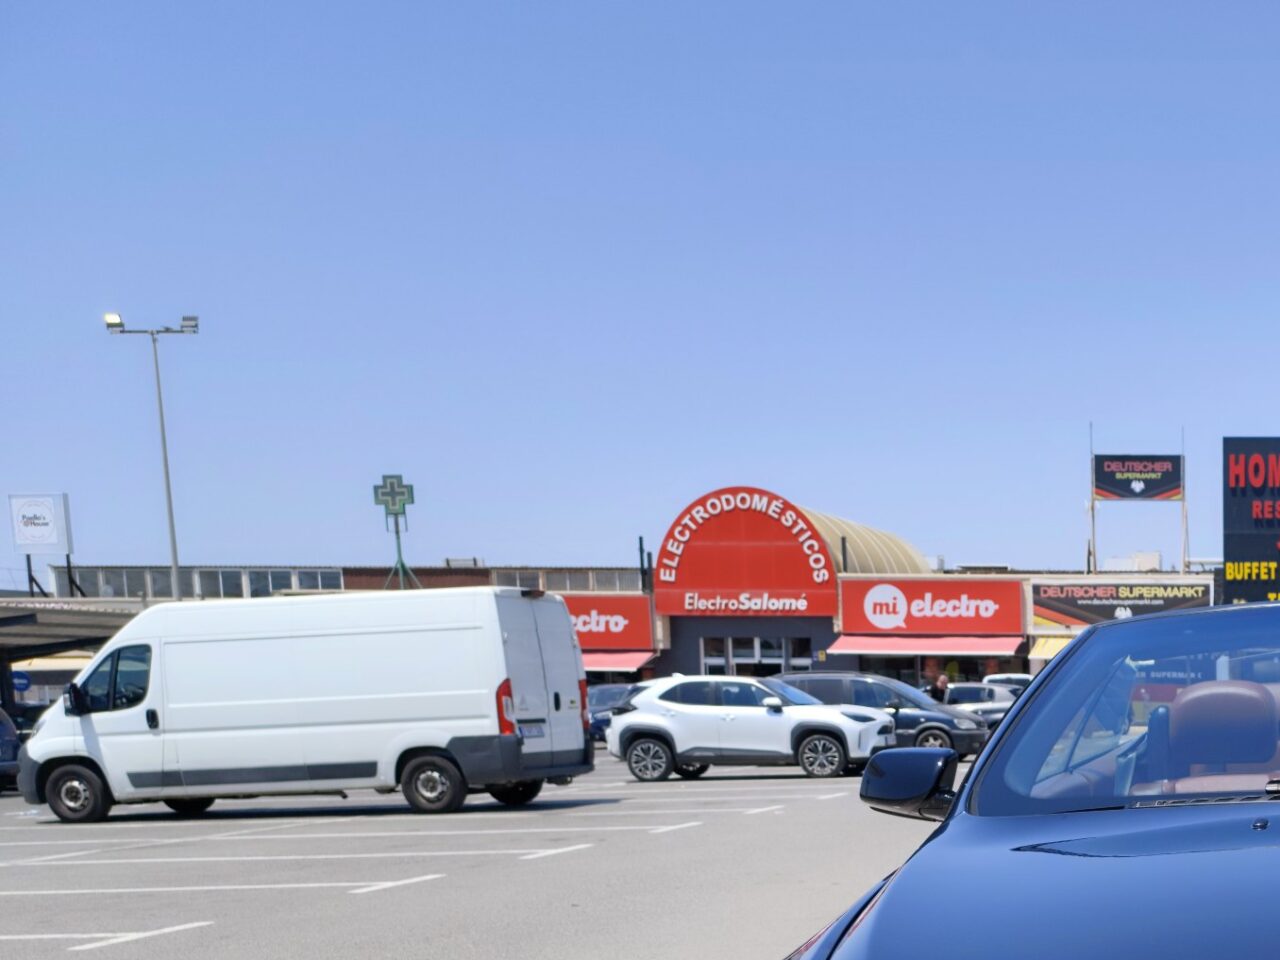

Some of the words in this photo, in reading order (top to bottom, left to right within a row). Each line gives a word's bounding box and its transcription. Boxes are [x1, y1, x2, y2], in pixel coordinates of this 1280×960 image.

[1103, 461, 1172, 472] DEUTSCHER
[659, 492, 829, 584] ELECTRODOMÉSTICOS
[1225, 561, 1278, 581] BUFFET
[684, 592, 808, 610] ElectroSalomé
[1040, 586, 1116, 598] DEUTSCHER
[1118, 586, 1205, 598] SUPERMARKT
[872, 597, 898, 615] mi
[910, 592, 999, 618] electro
